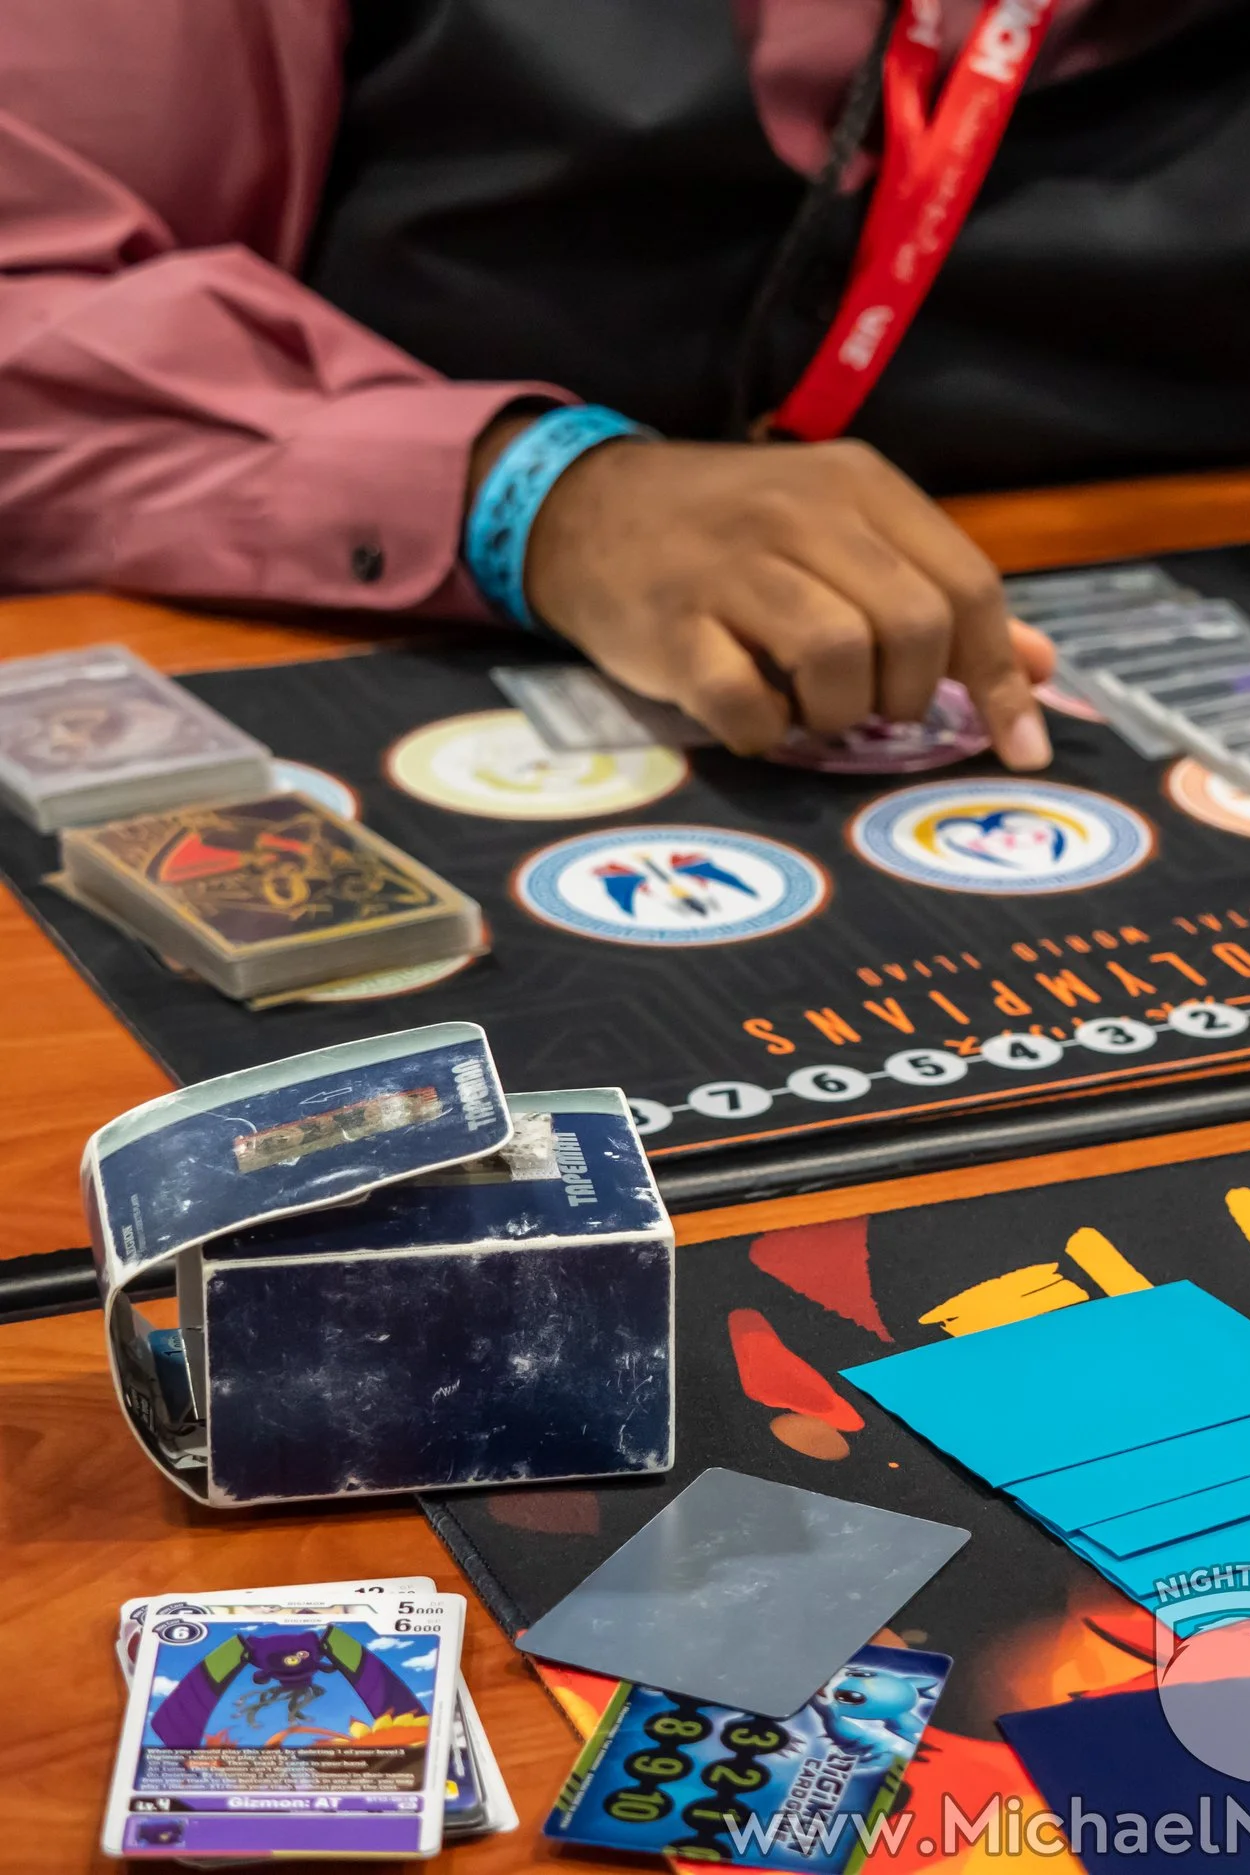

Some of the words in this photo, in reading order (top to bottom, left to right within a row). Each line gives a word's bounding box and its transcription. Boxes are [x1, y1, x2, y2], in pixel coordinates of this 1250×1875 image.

[708, 1088, 742, 1111] 7
[812, 1072, 847, 1094] 6
[908, 1056, 947, 1078] 5
[1007, 1040, 1040, 1060] 4
[1097, 1025, 1135, 1046] 3
[1189, 1010, 1229, 1031] 2
[172, 1626, 190, 1639] 6
[394, 1618, 441, 1632] 6000
[652, 1716, 700, 1738] 8
[729, 1726, 780, 1750] 3
[632, 1755, 685, 1778] 9
[710, 1763, 762, 1791] 2
[136, 1798, 171, 1812] Lv.4
[227, 1796, 310, 1810] Gizmon:
[314, 1796, 343, 1810] AT
[609, 1791, 661, 1822] 10
